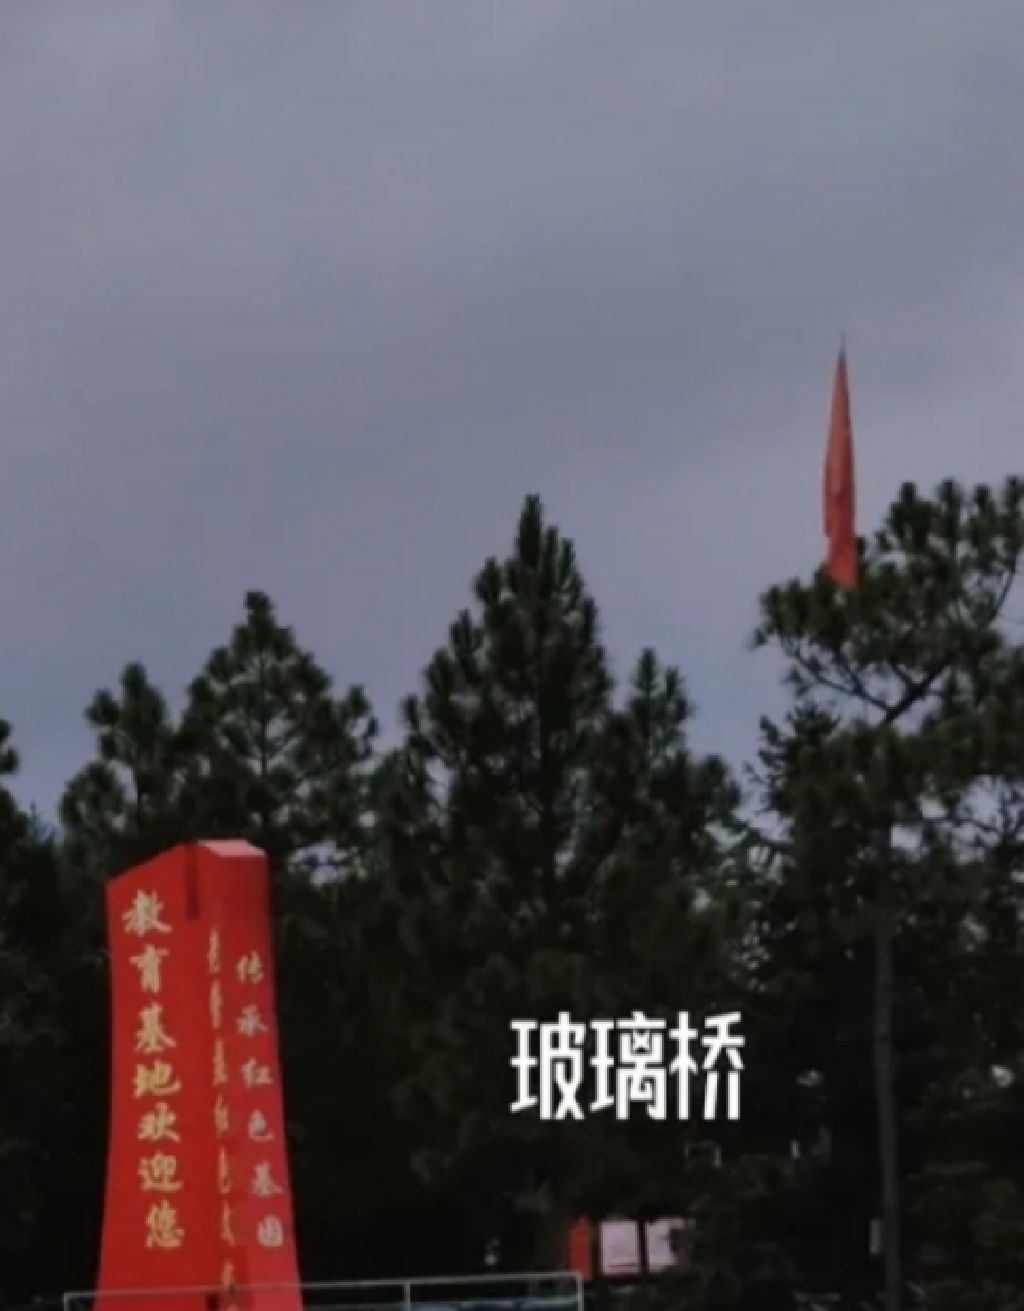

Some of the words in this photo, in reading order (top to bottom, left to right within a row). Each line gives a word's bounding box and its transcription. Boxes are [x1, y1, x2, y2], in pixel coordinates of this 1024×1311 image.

[122, 889, 185, 1249] 教育基地欢迎您
